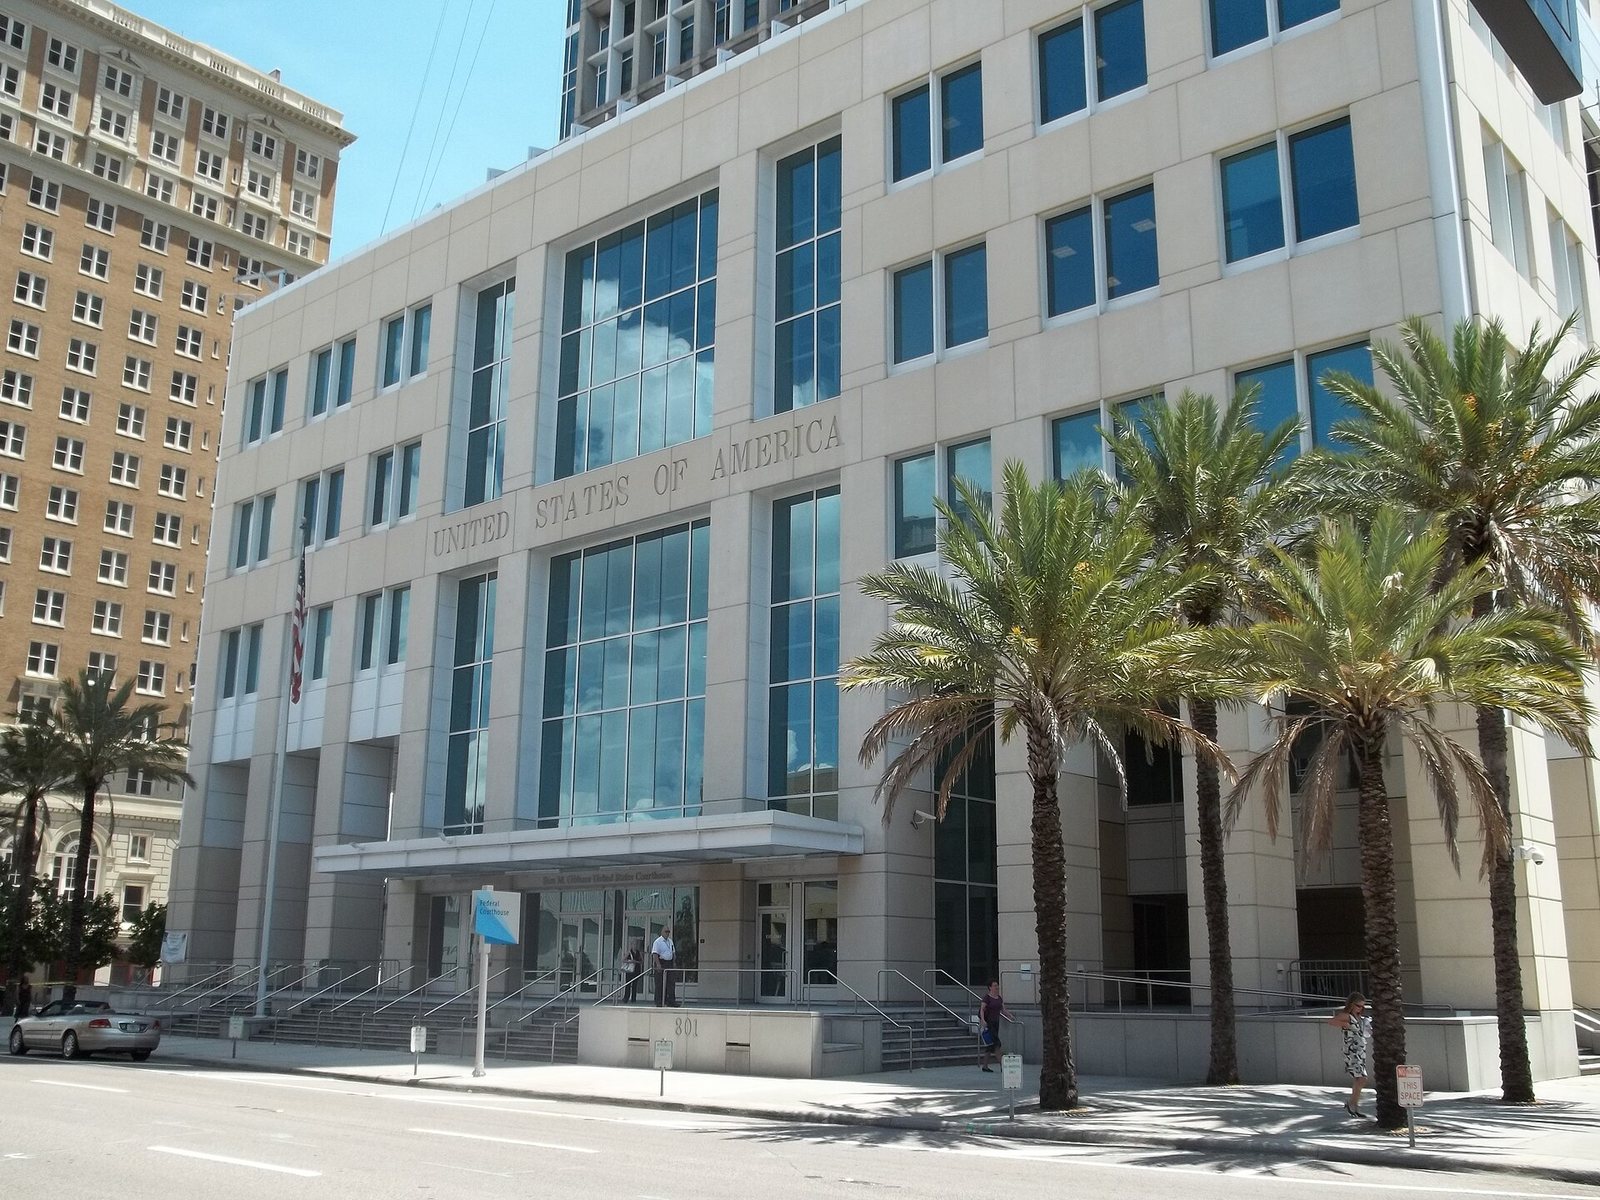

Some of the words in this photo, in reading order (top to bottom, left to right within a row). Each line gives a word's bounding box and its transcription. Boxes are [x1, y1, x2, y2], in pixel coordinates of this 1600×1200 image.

[433, 511, 510, 557] UNITED
[535, 475, 630, 529] STATES
[653, 458, 688, 496] OF
[711, 415, 844, 481] AMERICA
[675, 1016, 698, 1037] 801
[1402, 1082, 1417, 1090] THIS
[1400, 1091, 1421, 1100] SPACE
